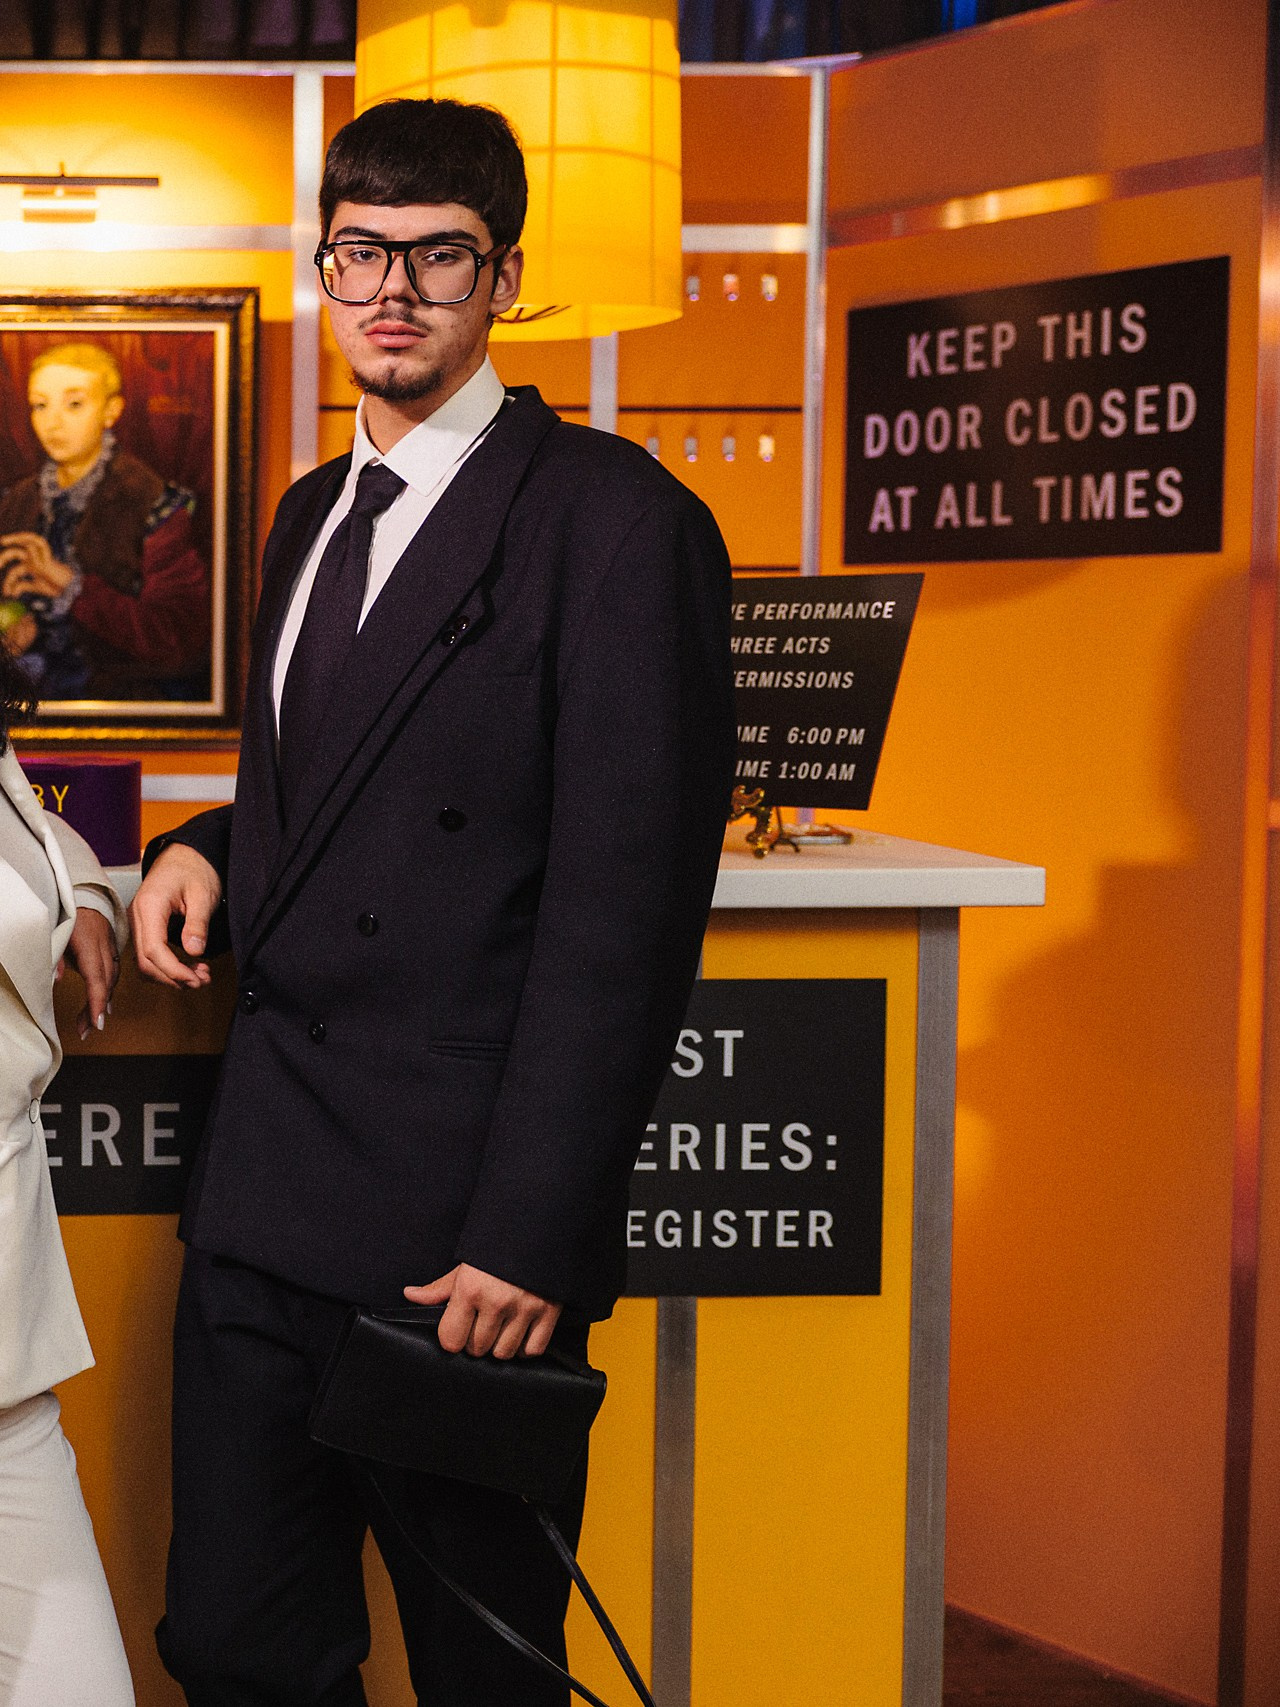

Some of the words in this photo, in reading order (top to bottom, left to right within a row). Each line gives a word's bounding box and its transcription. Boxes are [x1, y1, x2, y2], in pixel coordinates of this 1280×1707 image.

[907, 322, 1016, 378] KEEP
[1037, 304, 1147, 361] THIS
[864, 405, 981, 459] DOOR
[1006, 383, 1196, 445] CLOSED
[869, 486, 918, 533] AT
[935, 481, 1012, 529] ALL
[1033, 467, 1184, 523] TIMES
[752, 600, 897, 621] PERFORMANCE
[730, 636, 778, 655] HREE
[781, 636, 831, 655] ACTS
[733, 670, 855, 689] ERMISSIONS
[787, 726, 832, 745] 6:00
[835, 727, 866, 745] PM
[778, 761, 822, 780] 1:00
[824, 762, 856, 781] AM
[671, 1028, 745, 1078] ST
[626, 1209, 834, 1249] EGISTER
